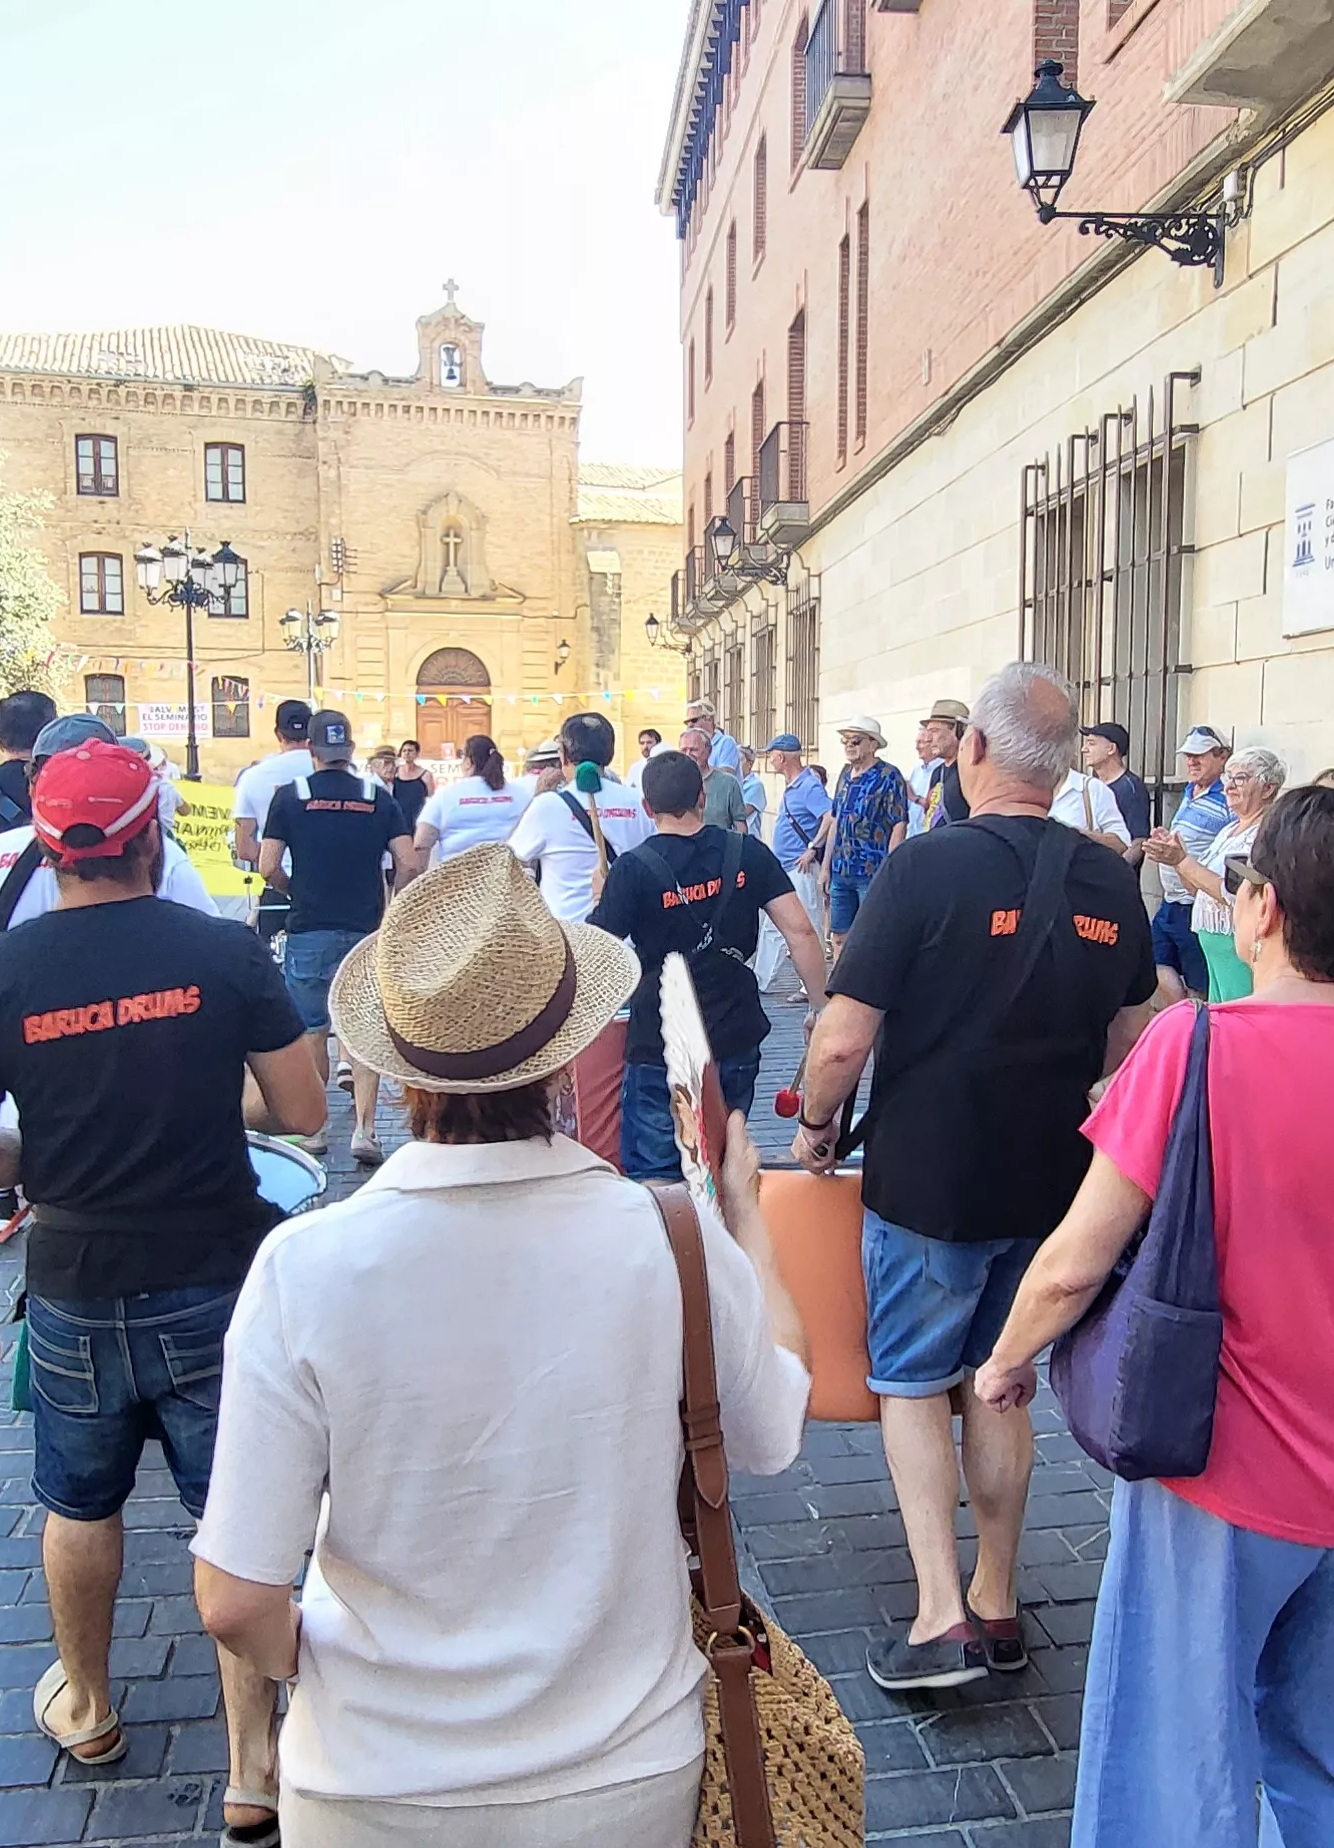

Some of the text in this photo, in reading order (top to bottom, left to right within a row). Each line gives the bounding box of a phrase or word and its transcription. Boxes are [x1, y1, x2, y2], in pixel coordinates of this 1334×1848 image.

[155, 713, 208, 721] SEMINAIO
[1073, 914, 1119, 946] RUMS
[23, 985, 201, 1044] BARUCA DRUMS
